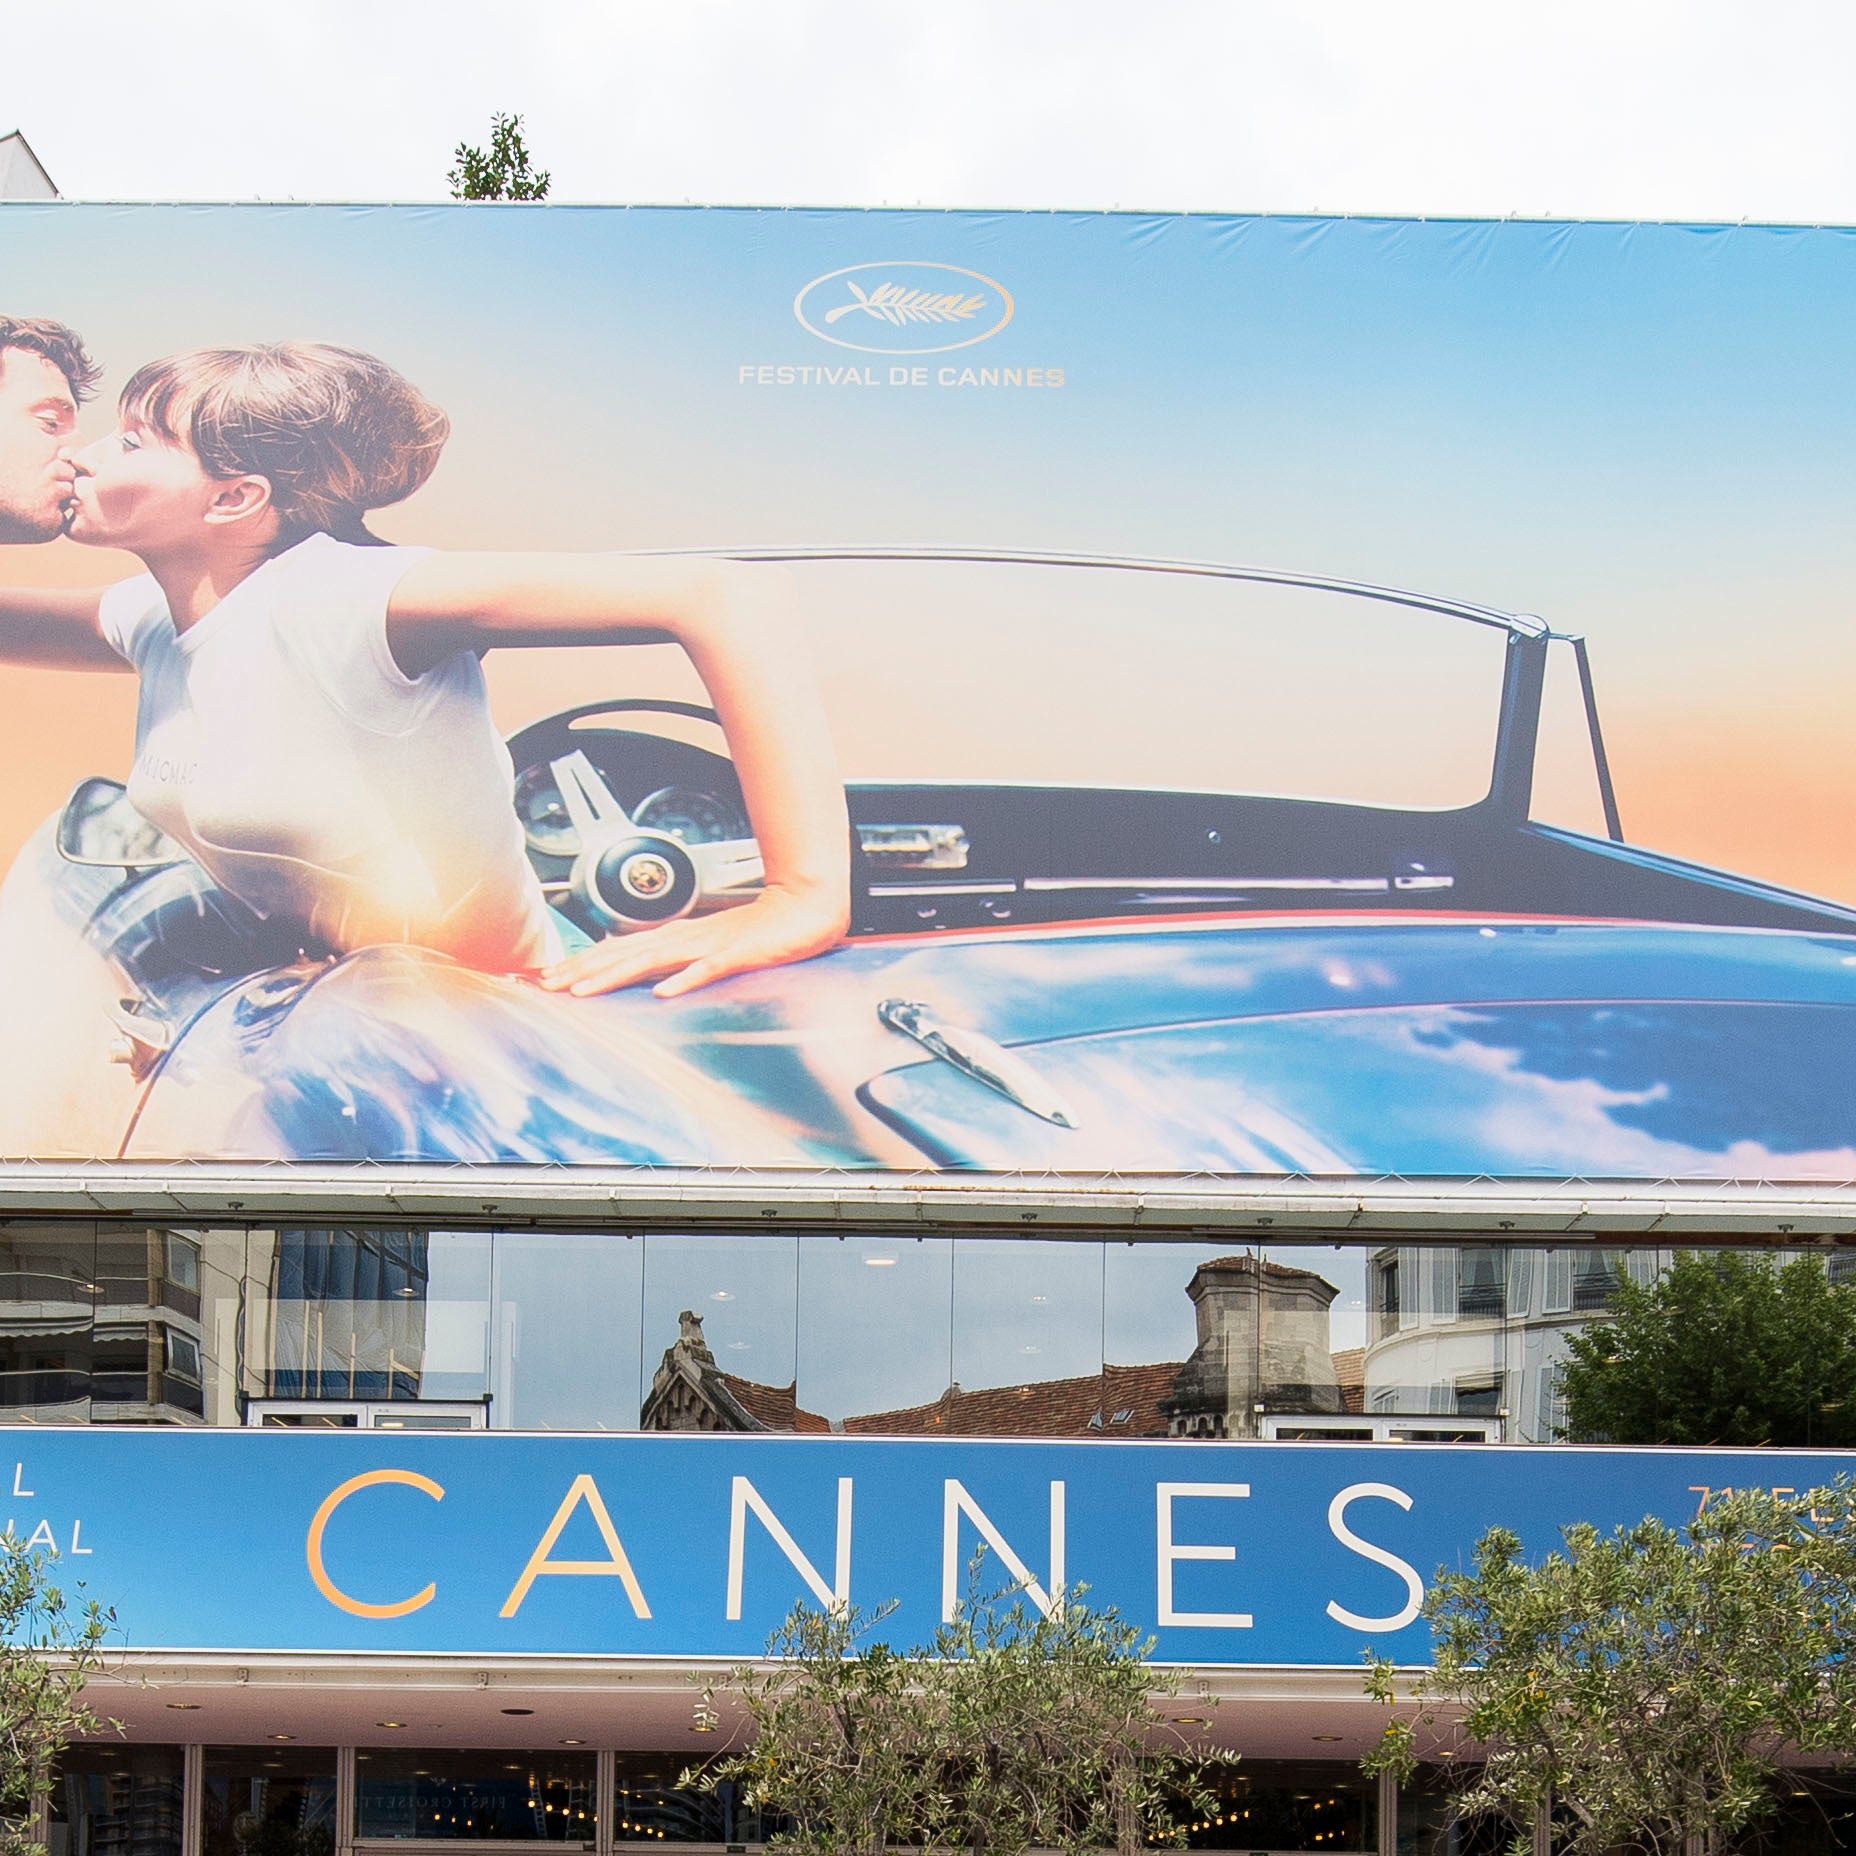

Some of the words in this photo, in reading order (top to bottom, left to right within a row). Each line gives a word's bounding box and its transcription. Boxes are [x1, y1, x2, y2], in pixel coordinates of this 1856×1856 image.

[738, 365, 881, 387] FESTIVAL
[888, 366, 929, 387] DE
[937, 366, 1066, 388] CANNES
[306, 1468, 1426, 1632] CANNES
